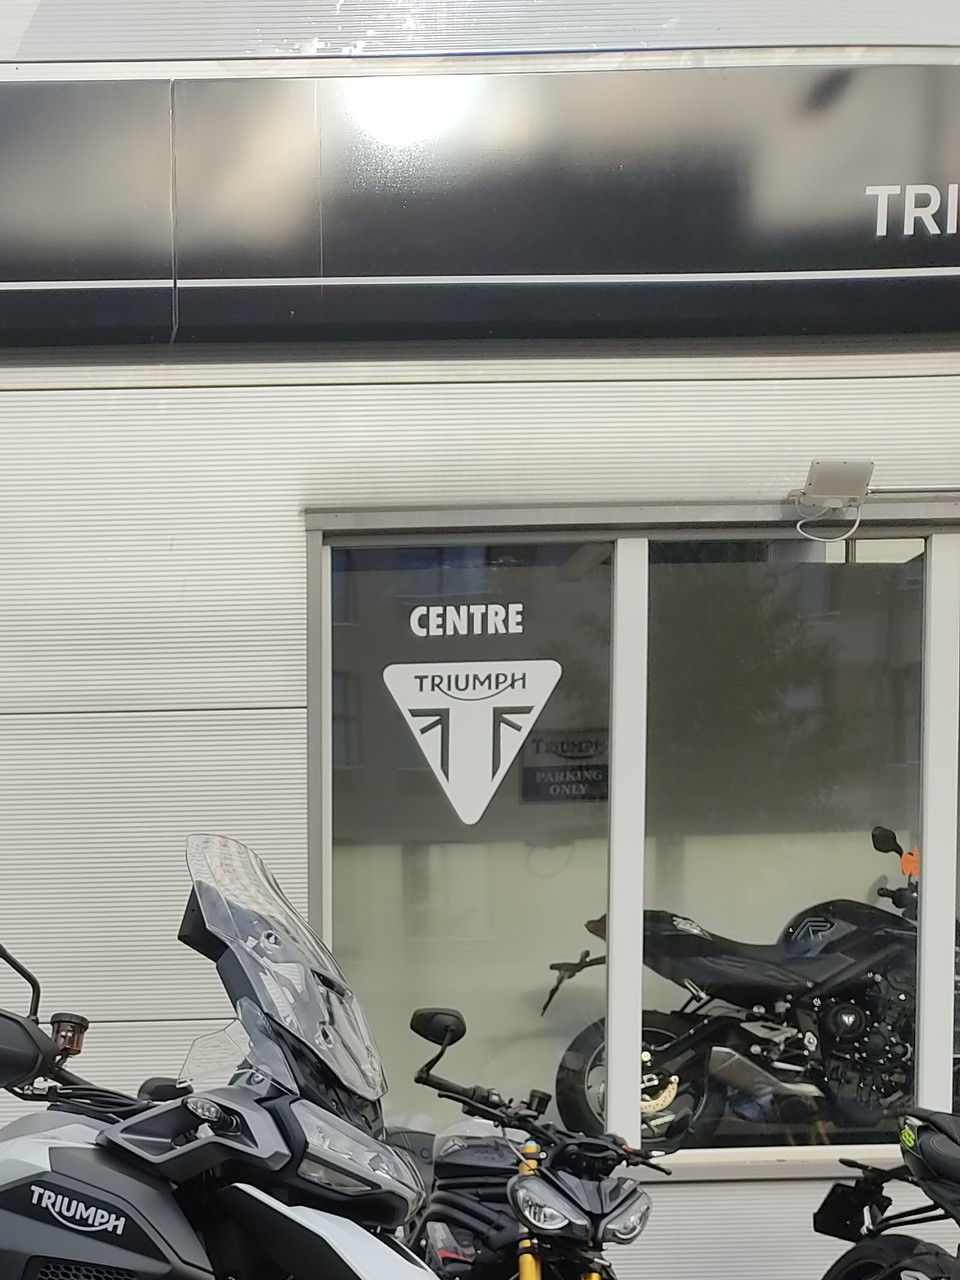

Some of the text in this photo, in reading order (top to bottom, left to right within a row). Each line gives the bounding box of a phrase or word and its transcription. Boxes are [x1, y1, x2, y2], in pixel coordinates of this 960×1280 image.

[865, 183, 959, 237] TRI
[409, 603, 524, 637] CENTRE
[414, 672, 527, 700] TRIUMPH
[535, 769, 603, 783] PARKING
[549, 783, 588, 796] ONLY
[30, 1184, 126, 1236] TRIUMPH
